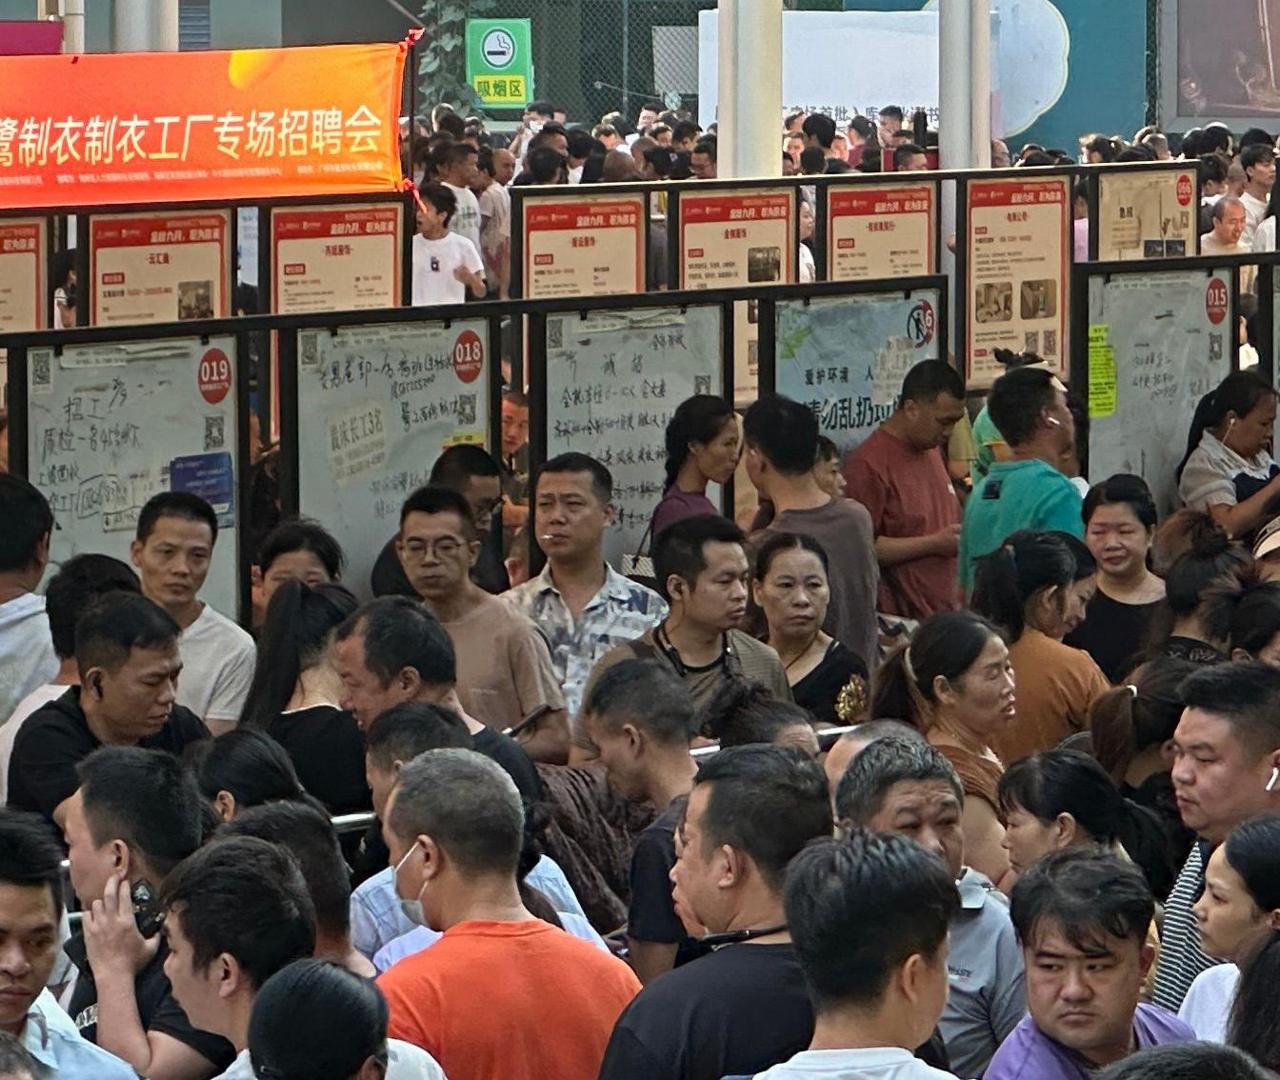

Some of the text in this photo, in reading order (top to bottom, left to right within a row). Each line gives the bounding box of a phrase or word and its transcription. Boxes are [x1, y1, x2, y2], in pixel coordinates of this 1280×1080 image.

[477, 80, 522, 97] 吸烟区
[1207, 288, 1226, 305] 015
[456, 342, 480, 363] 018
[201, 361, 228, 381] 019
[805, 367, 849, 385] 爱护环境
